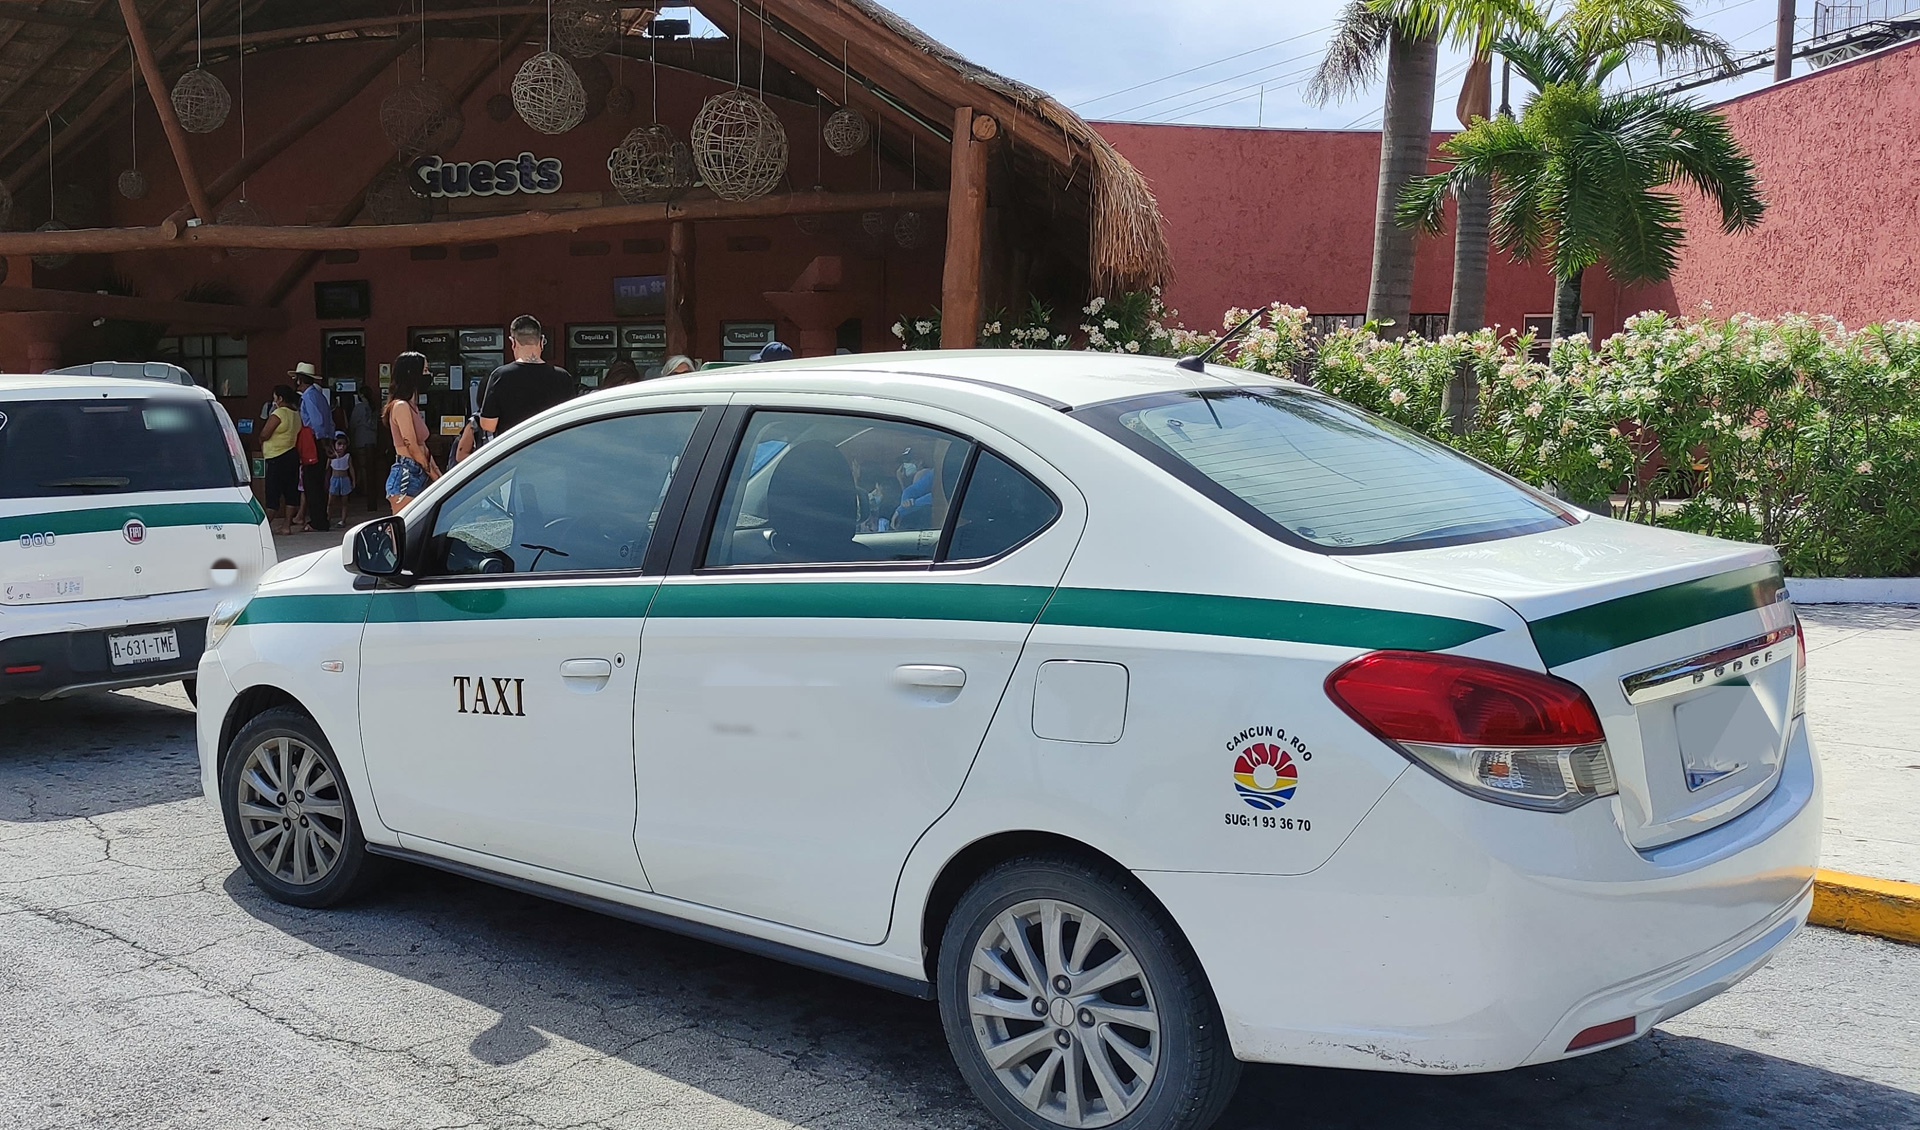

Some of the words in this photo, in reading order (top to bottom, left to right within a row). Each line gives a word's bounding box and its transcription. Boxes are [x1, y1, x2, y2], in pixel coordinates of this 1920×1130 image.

[408, 152, 562, 197] Guests
[620, 284, 648, 297] FILA
[334, 338, 354, 346] Taquilla
[466, 336, 488, 344] Taquilla
[632, 333, 656, 341] Taquilla
[734, 332, 757, 341] Taquilla
[129, 526, 142, 538] FIAT
[113, 636, 176, 659] A-631-TME
[1692, 651, 1773, 685] DODGE
[453, 676, 526, 716] TAXI
[1226, 726, 1273, 752] CANCUN
[1276, 728, 1288, 742] Q.
[1290, 736, 1312, 762] ROO
[1224, 813, 1250, 826] SUG:
[1262, 816, 1276, 828] 93
[1280, 818, 1294, 830] 36
[1297, 820, 1311, 832] 70
